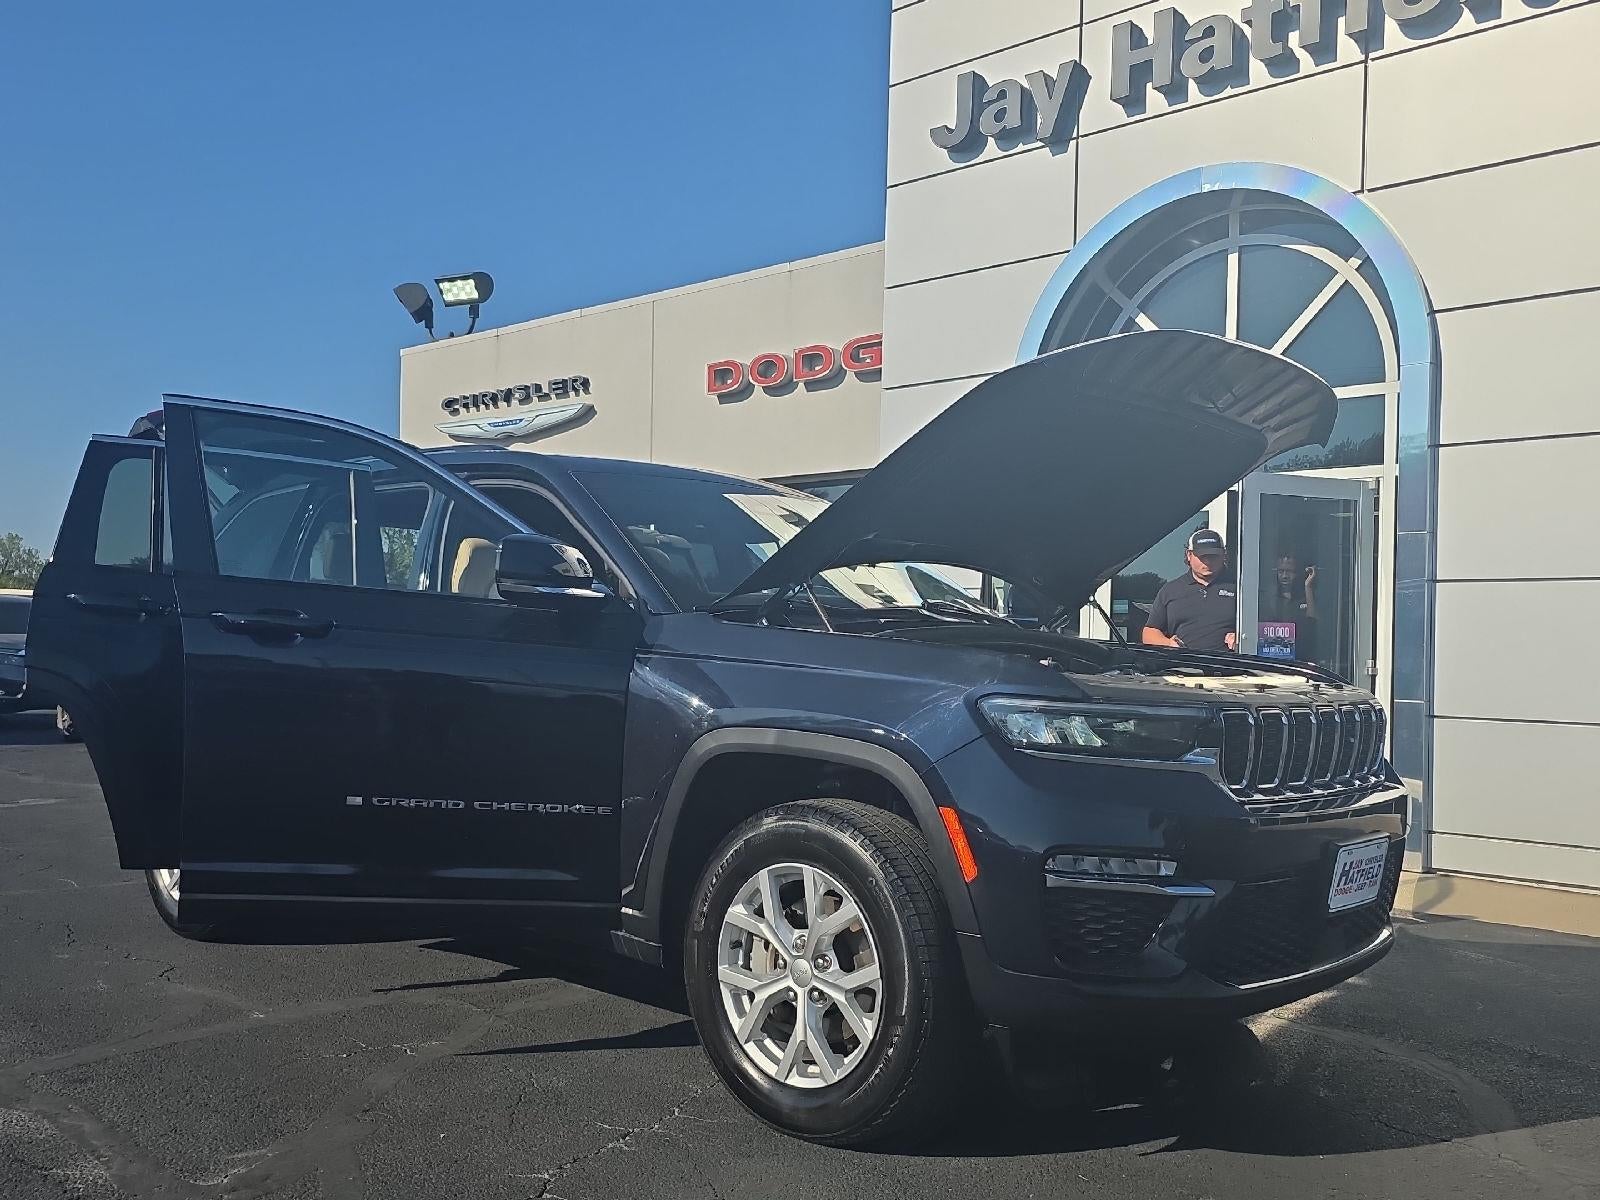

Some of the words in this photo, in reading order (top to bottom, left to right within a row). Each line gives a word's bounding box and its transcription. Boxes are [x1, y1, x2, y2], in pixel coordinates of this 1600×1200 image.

[930, 60, 1086, 150] Jay
[441, 375, 588, 414] CHRYSLER
[371, 796, 465, 808] GRAND
[473, 800, 613, 815] CHEROKEE
[1336, 862, 1382, 888] HATFIELD
